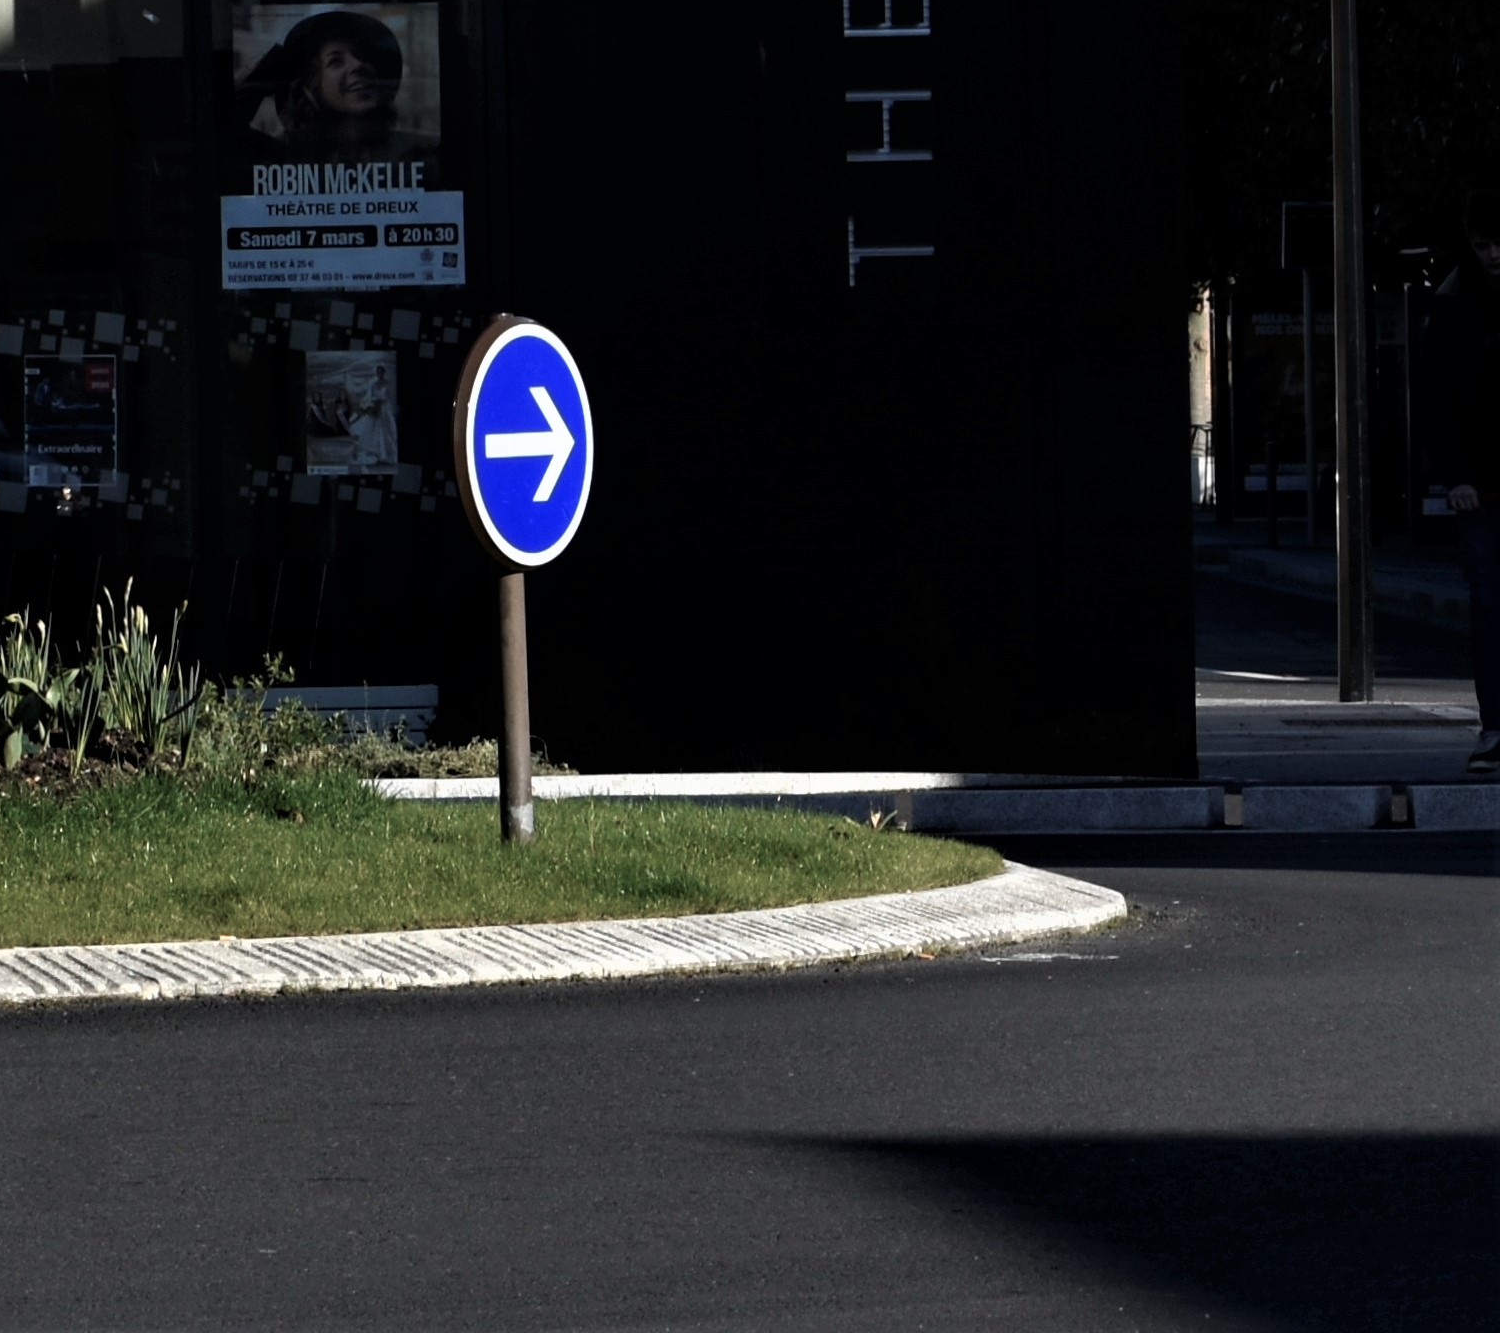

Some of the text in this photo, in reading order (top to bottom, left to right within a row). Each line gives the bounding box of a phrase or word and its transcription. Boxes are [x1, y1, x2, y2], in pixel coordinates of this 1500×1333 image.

[253, 163, 319, 195] ROBIN
[340, 201, 361, 216] DE
[365, 200, 419, 215] DREUX
[240, 230, 365, 248] Samedi 7 mars
